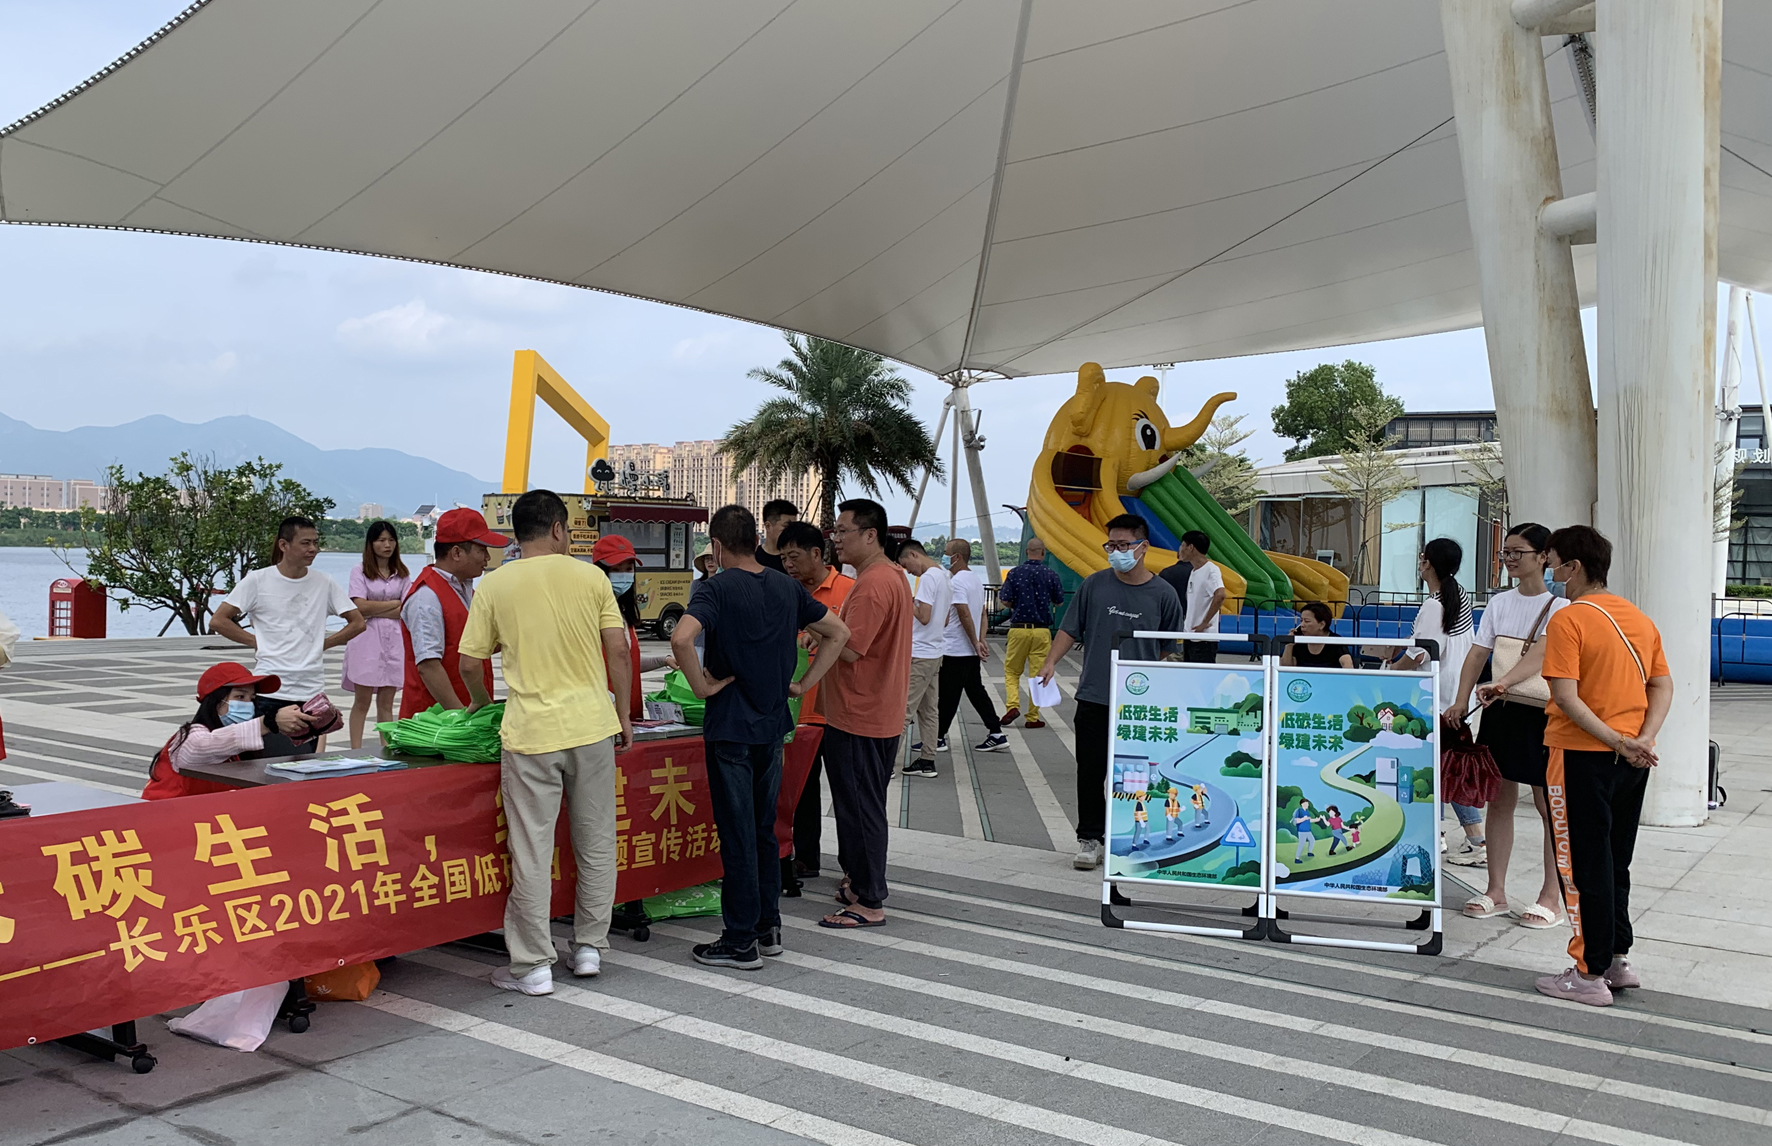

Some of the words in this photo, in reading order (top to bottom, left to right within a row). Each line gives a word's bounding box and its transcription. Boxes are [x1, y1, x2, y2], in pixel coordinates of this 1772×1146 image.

[1117, 702, 1179, 723] 低碳生活
[1278, 711, 1344, 731] 低碳生活
[1116, 724, 1179, 744] 绿建未来
[1278, 732, 1345, 752] 绿建未来
[1323, 881, 1388, 893] 中华人民共和国生态环境部
